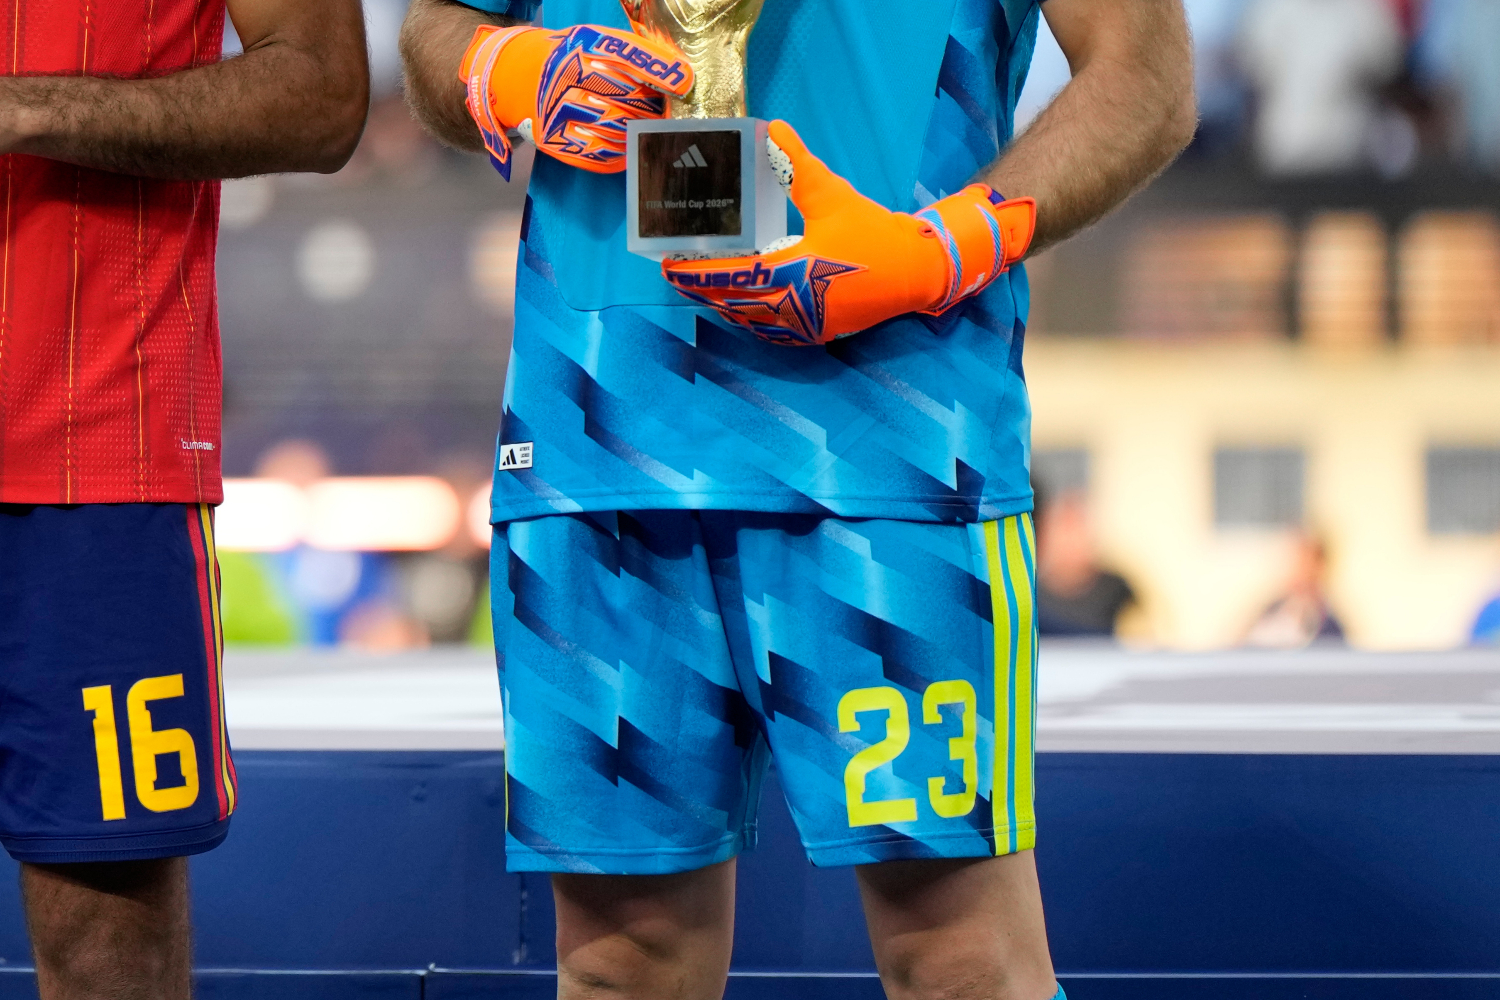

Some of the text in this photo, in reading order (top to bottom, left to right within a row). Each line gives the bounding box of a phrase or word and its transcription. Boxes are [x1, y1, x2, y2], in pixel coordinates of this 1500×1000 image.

[595, 35, 684, 86] reusch
[646, 200, 663, 209] FIFA
[664, 200, 686, 208] World
[688, 200, 704, 210] Cup
[666, 262, 770, 288] reusch
[82, 673, 199, 821] 16
[837, 679, 978, 828] 23
